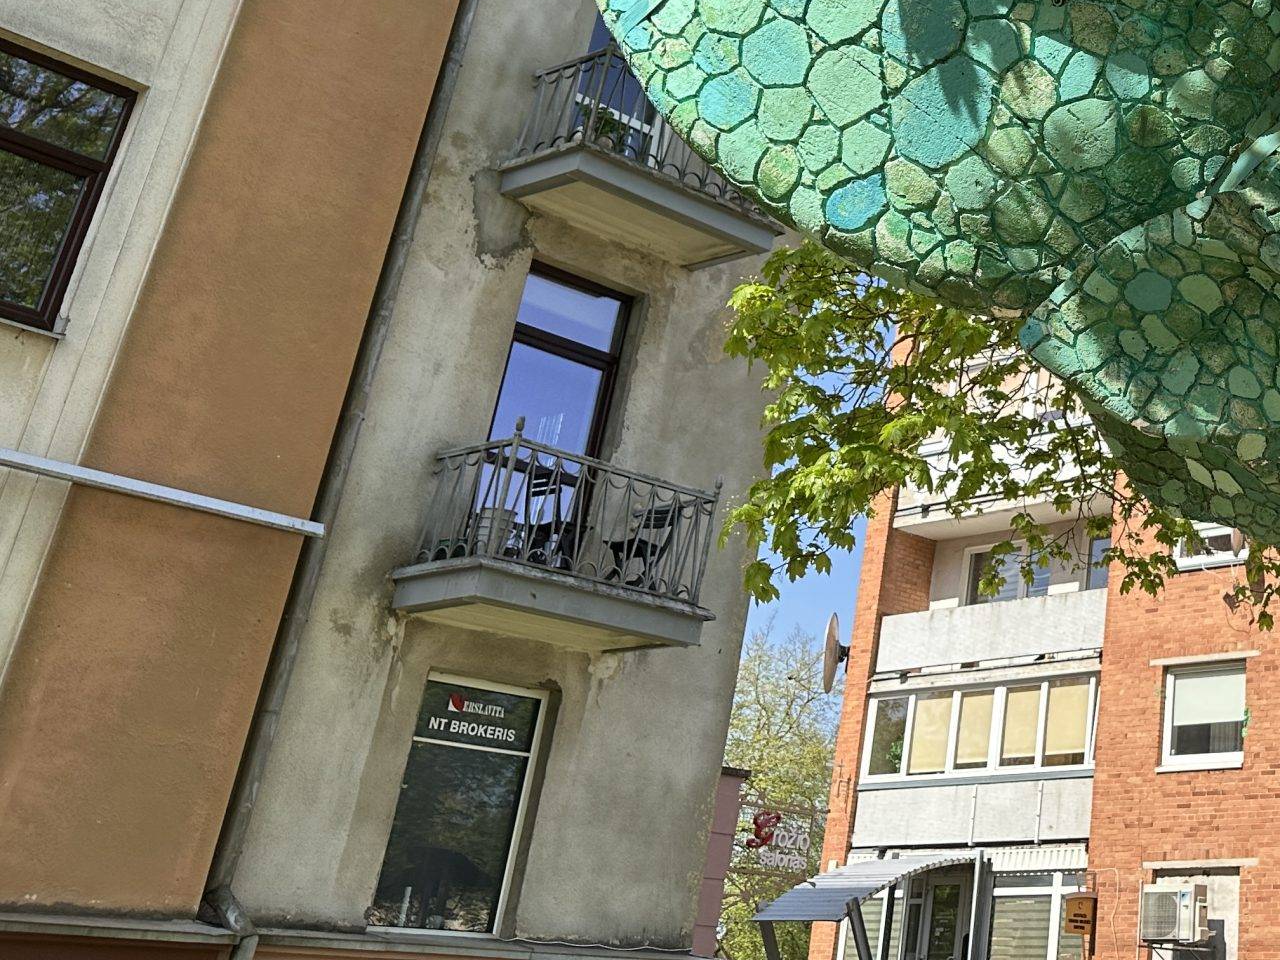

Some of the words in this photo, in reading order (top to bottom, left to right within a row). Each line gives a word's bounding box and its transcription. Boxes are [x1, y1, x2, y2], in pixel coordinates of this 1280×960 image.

[428, 716, 448, 731] NT
[450, 720, 516, 742] BROKERIS
[759, 849, 808, 871] salonas
